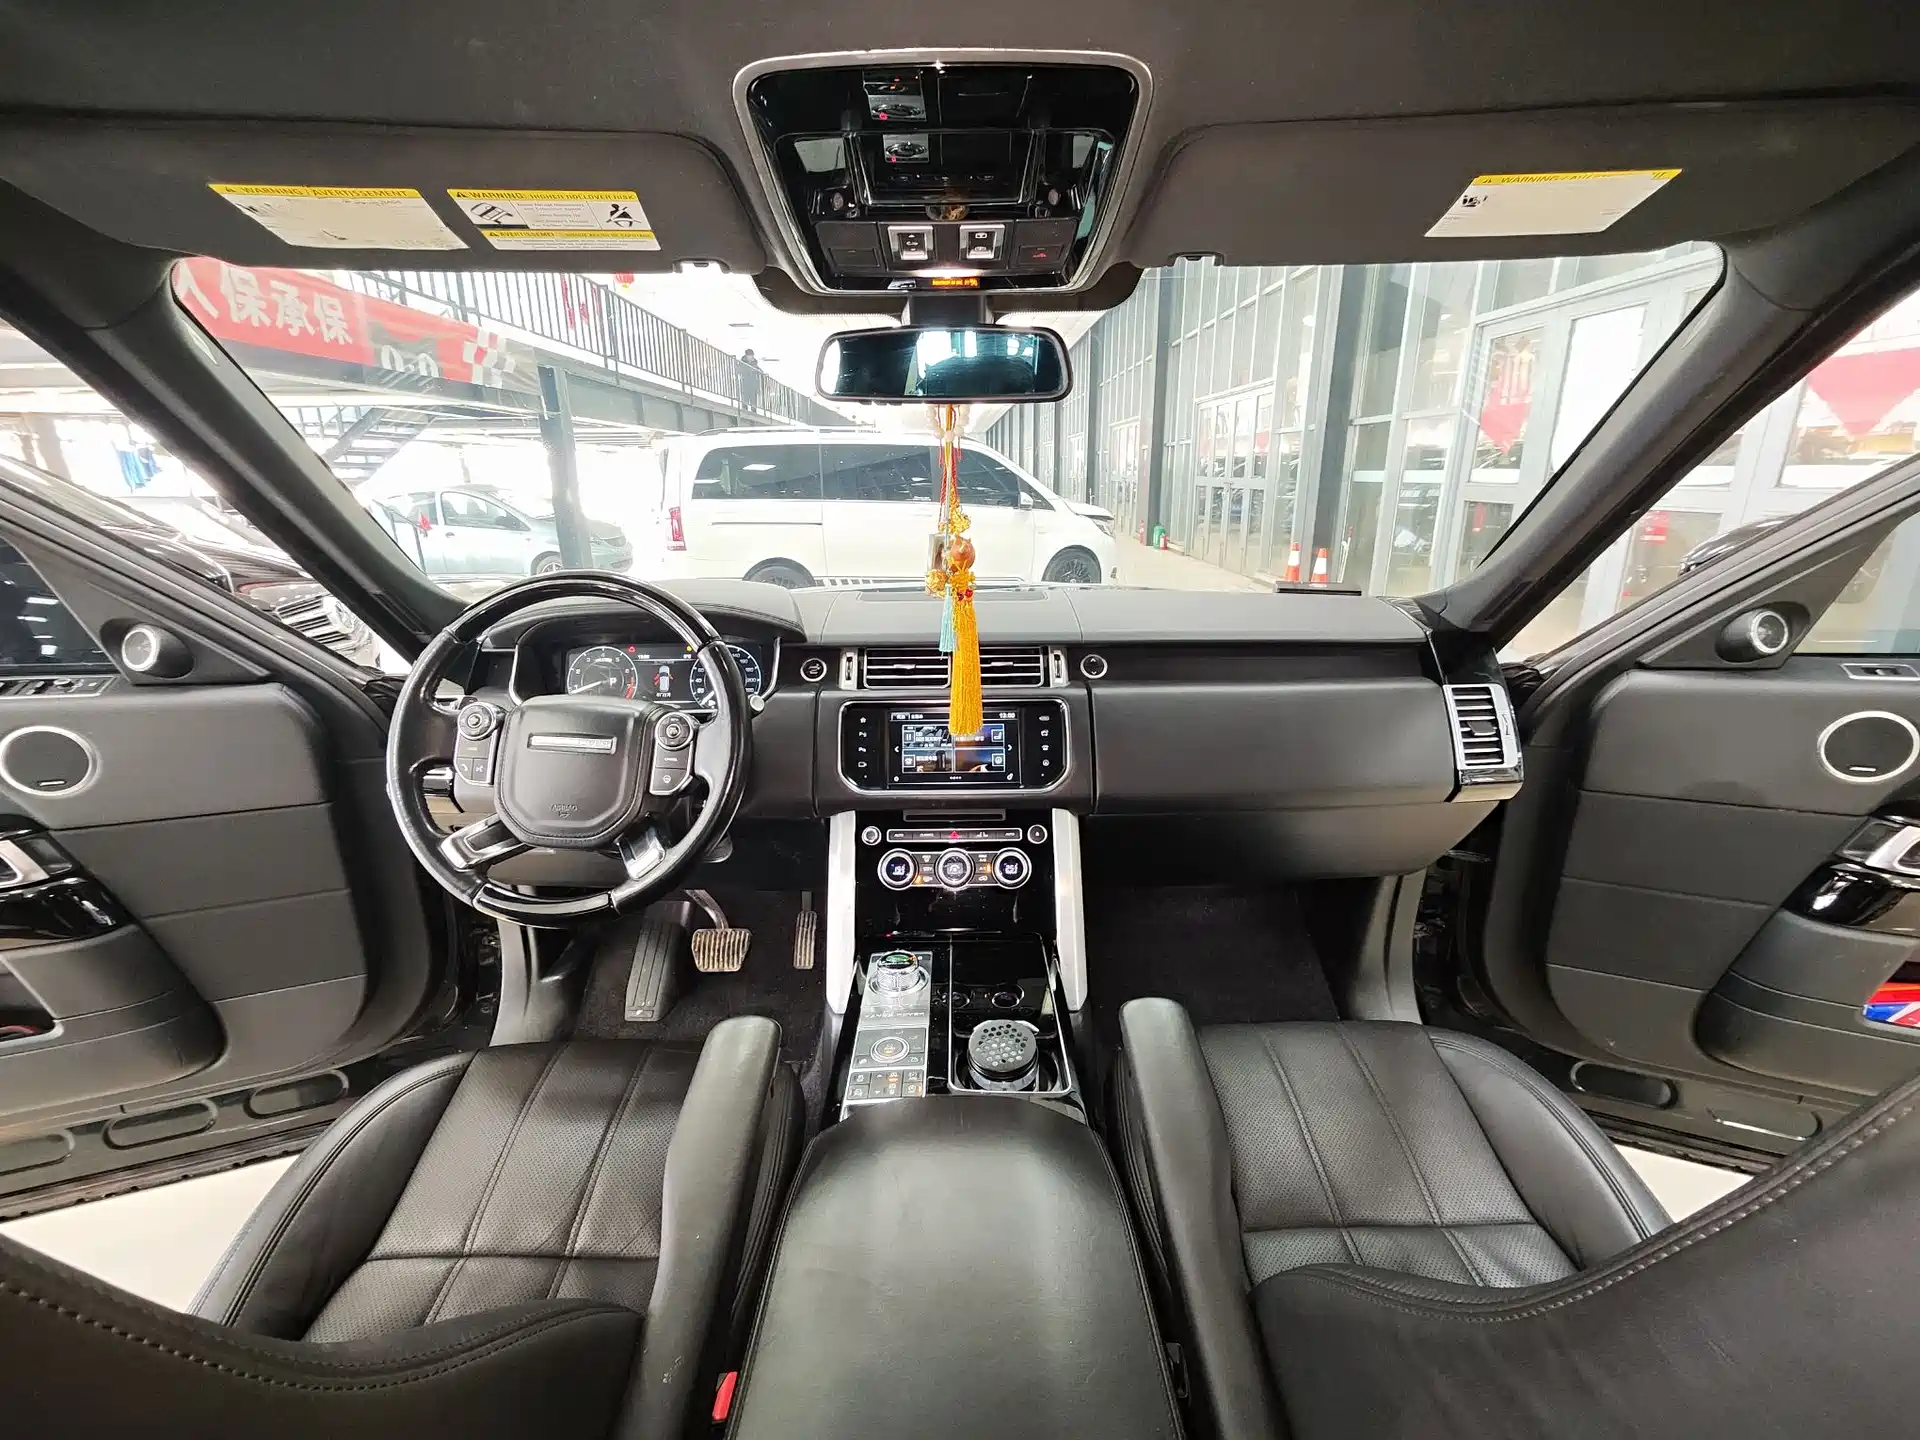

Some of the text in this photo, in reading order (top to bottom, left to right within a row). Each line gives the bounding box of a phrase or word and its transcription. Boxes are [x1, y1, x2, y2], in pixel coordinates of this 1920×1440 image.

[241, 187, 301, 196] WARNING
[311, 188, 408, 197] AVERTISSEMENT
[174, 261, 353, 345] 人保承保
